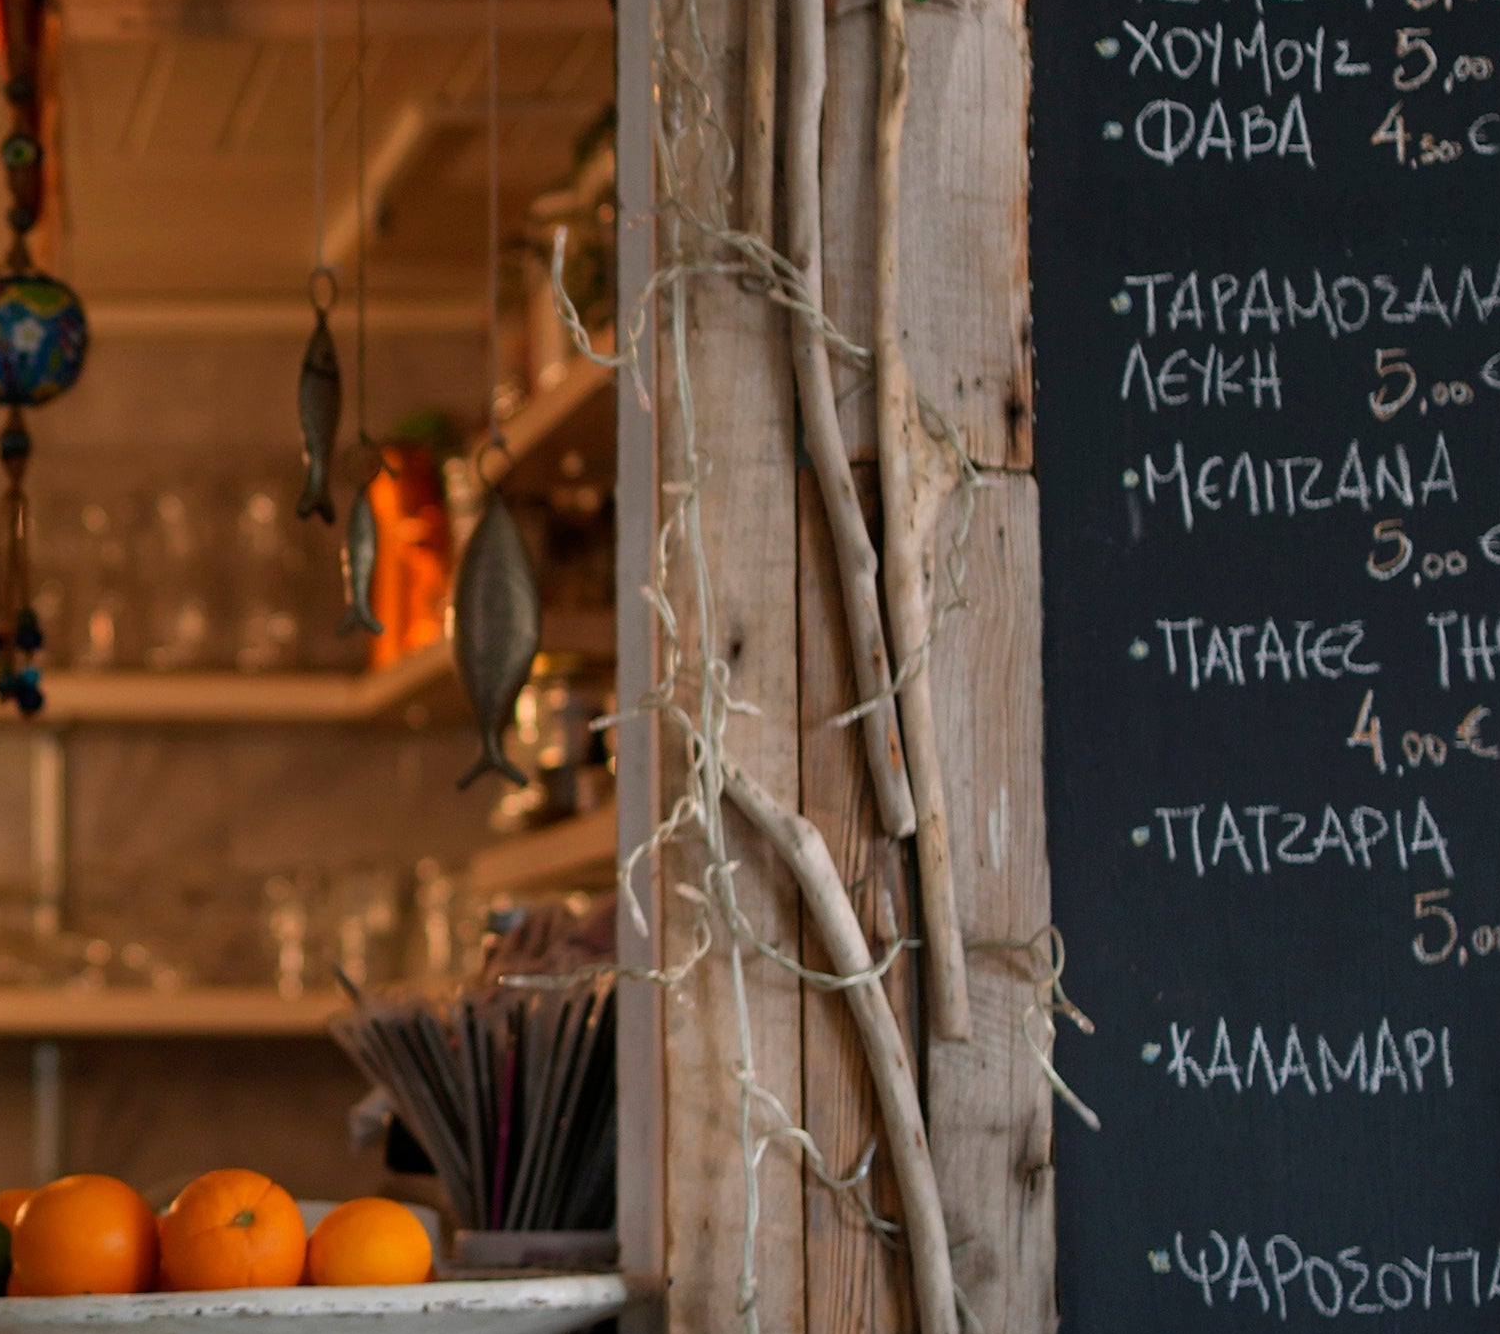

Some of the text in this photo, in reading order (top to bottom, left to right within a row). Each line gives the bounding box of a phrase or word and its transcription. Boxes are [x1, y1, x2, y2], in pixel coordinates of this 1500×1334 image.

[1122, 19, 1371, 95] ΧΟΥΜΟΥΣ
[1135, 94, 1316, 168] ΦΑΒΑ
[1121, 342, 1282, 412] ΛΕΥΚΗ
[1155, 796, 1455, 878] ΠΑΤΖΑΡΙΑ
[1166, 1016, 1455, 1096] ΚΑΛΑΜΑΡΙ
